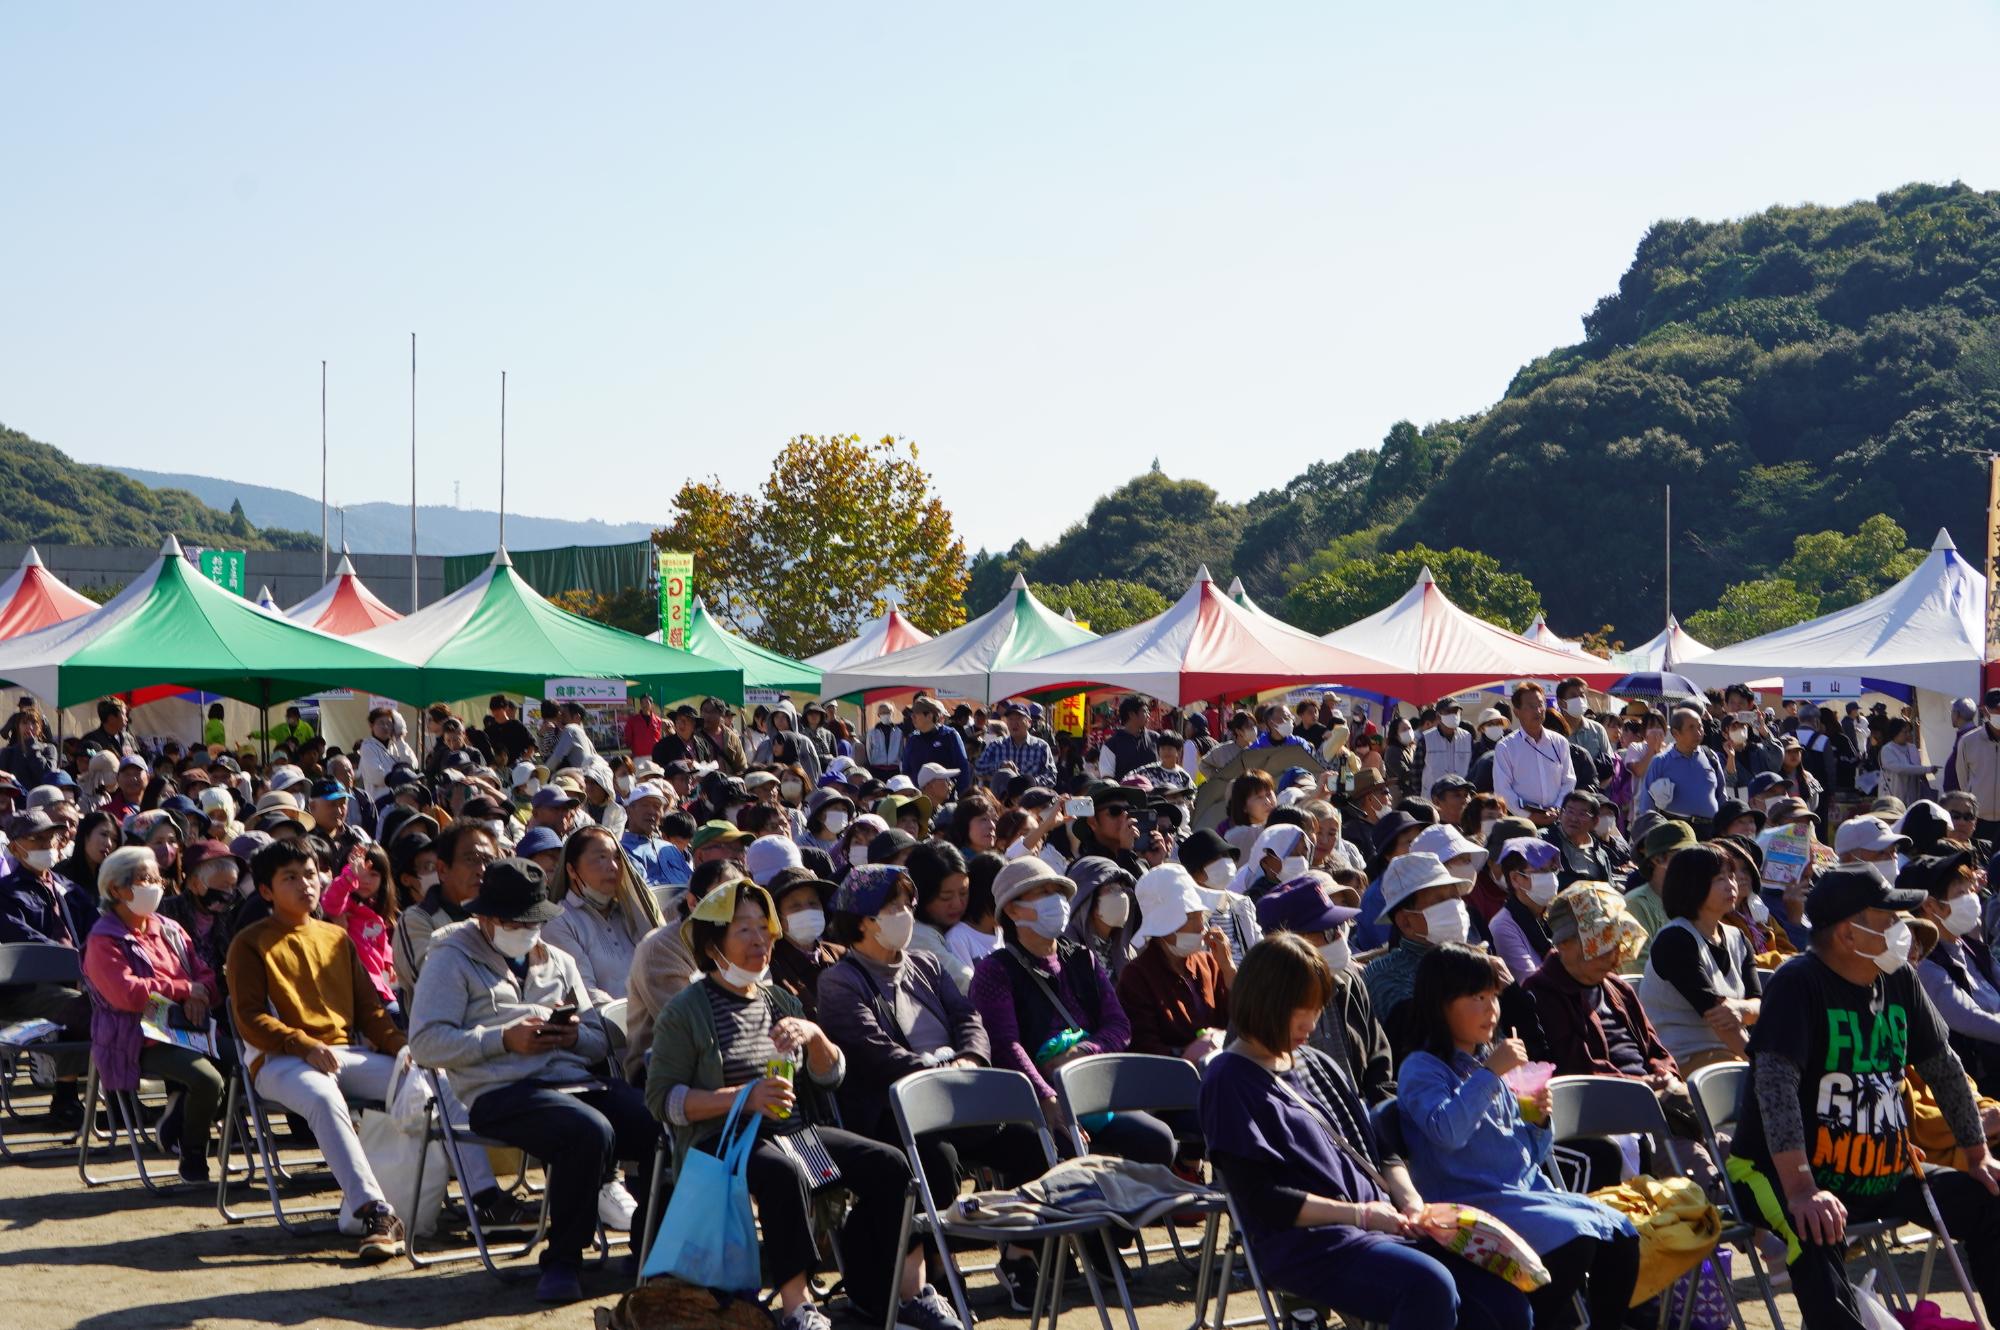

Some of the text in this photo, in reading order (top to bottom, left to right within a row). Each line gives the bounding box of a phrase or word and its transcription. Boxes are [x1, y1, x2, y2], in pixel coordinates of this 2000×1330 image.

[555, 685, 617, 697] 食事スペース
